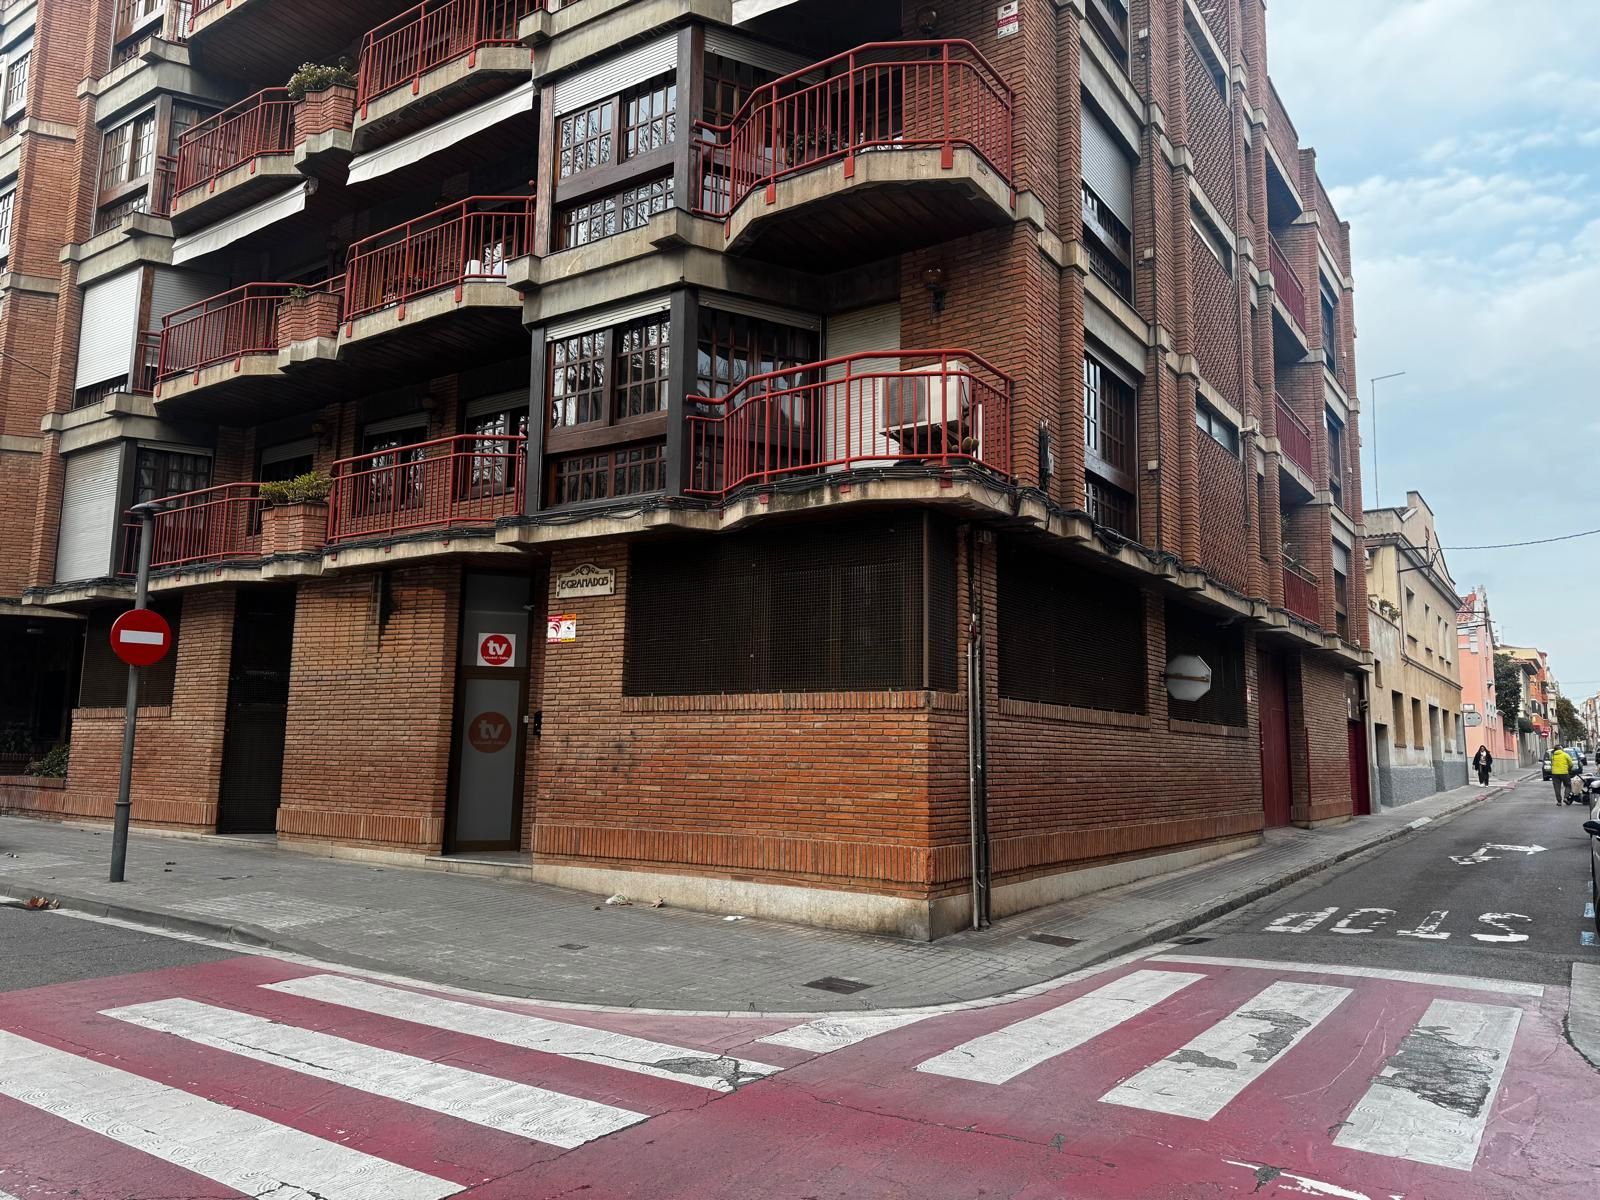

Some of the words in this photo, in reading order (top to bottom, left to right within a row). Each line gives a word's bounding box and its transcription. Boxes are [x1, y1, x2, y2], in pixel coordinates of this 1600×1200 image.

[487, 640, 507, 655] tv
[479, 720, 504, 739] tv
[1262, 906, 1532, 942] STOP
